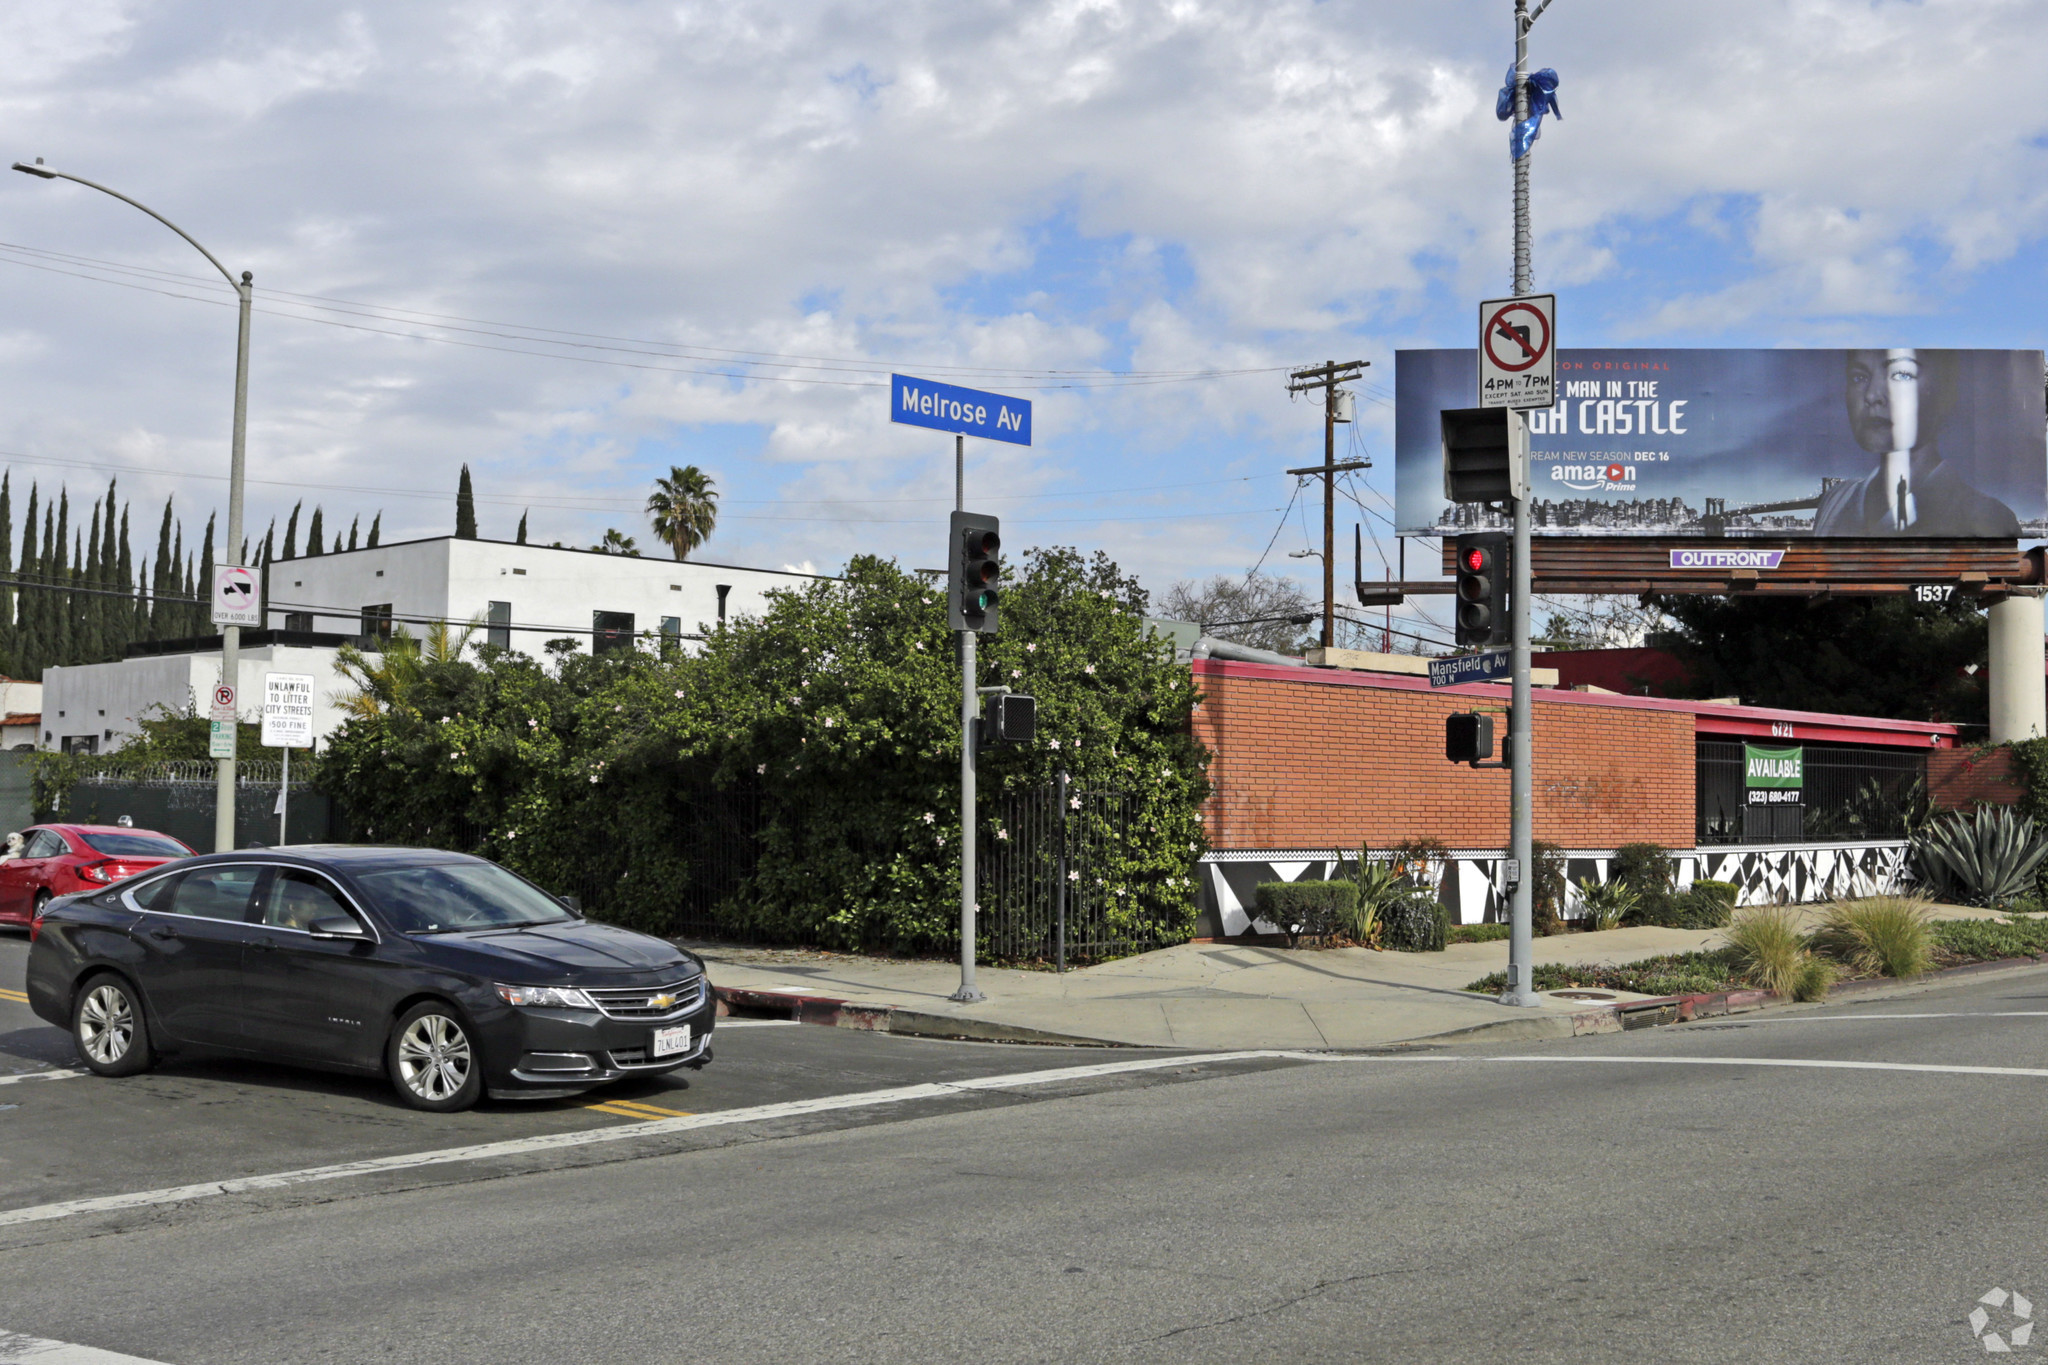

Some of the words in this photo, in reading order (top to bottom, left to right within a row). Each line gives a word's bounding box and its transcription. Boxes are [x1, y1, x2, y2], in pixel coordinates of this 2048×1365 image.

[1592, 361, 1670, 371] ORIGINAL
[1485, 377, 1514, 391] 4PM
[1522, 374, 1550, 388] 7PM
[1566, 380, 1600, 398] MAN
[1606, 380, 1622, 398] IN
[1626, 380, 1659, 398] THE
[1485, 392, 1508, 400] EXCEPT
[902, 385, 987, 425] Melrose
[996, 405, 1023, 432] Av
[1528, 400, 1567, 434] GH
[1579, 400, 1689, 435] CASTLE
[1530, 451, 1560, 461] REAM
[1563, 451, 1587, 461] NEW
[1589, 451, 1632, 461] SEASON
[1634, 451, 1656, 461] DEC
[1659, 451, 1670, 461] 16
[1605, 482, 1637, 492] Prime
[1681, 552, 1772, 566] OUTFRONT
[1915, 585, 1954, 602] 1537
[214, 611, 228, 620] OVER
[230, 613, 246, 621] 6000
[1431, 657, 1481, 676] Mansfield
[1494, 653, 1507, 668] Av
[1432, 675, 1447, 686] 700
[1449, 674, 1455, 684] N
[268, 681, 311, 693] UNLAWFUL
[270, 693, 280, 703] TO
[283, 694, 308, 704] LITTER
[265, 704, 281, 714] CITY
[283, 705, 312, 716] STREETS
[212, 722, 219, 731] 2
[289, 721, 307, 730] FINE
[1772, 721, 1794, 738] 6721
[1747, 758, 1801, 778] AVAILABLE
[1748, 790, 1767, 804] (323)
[1768, 791, 1800, 803] 680-4177
[657, 1035, 688, 1052] 7LNL401
